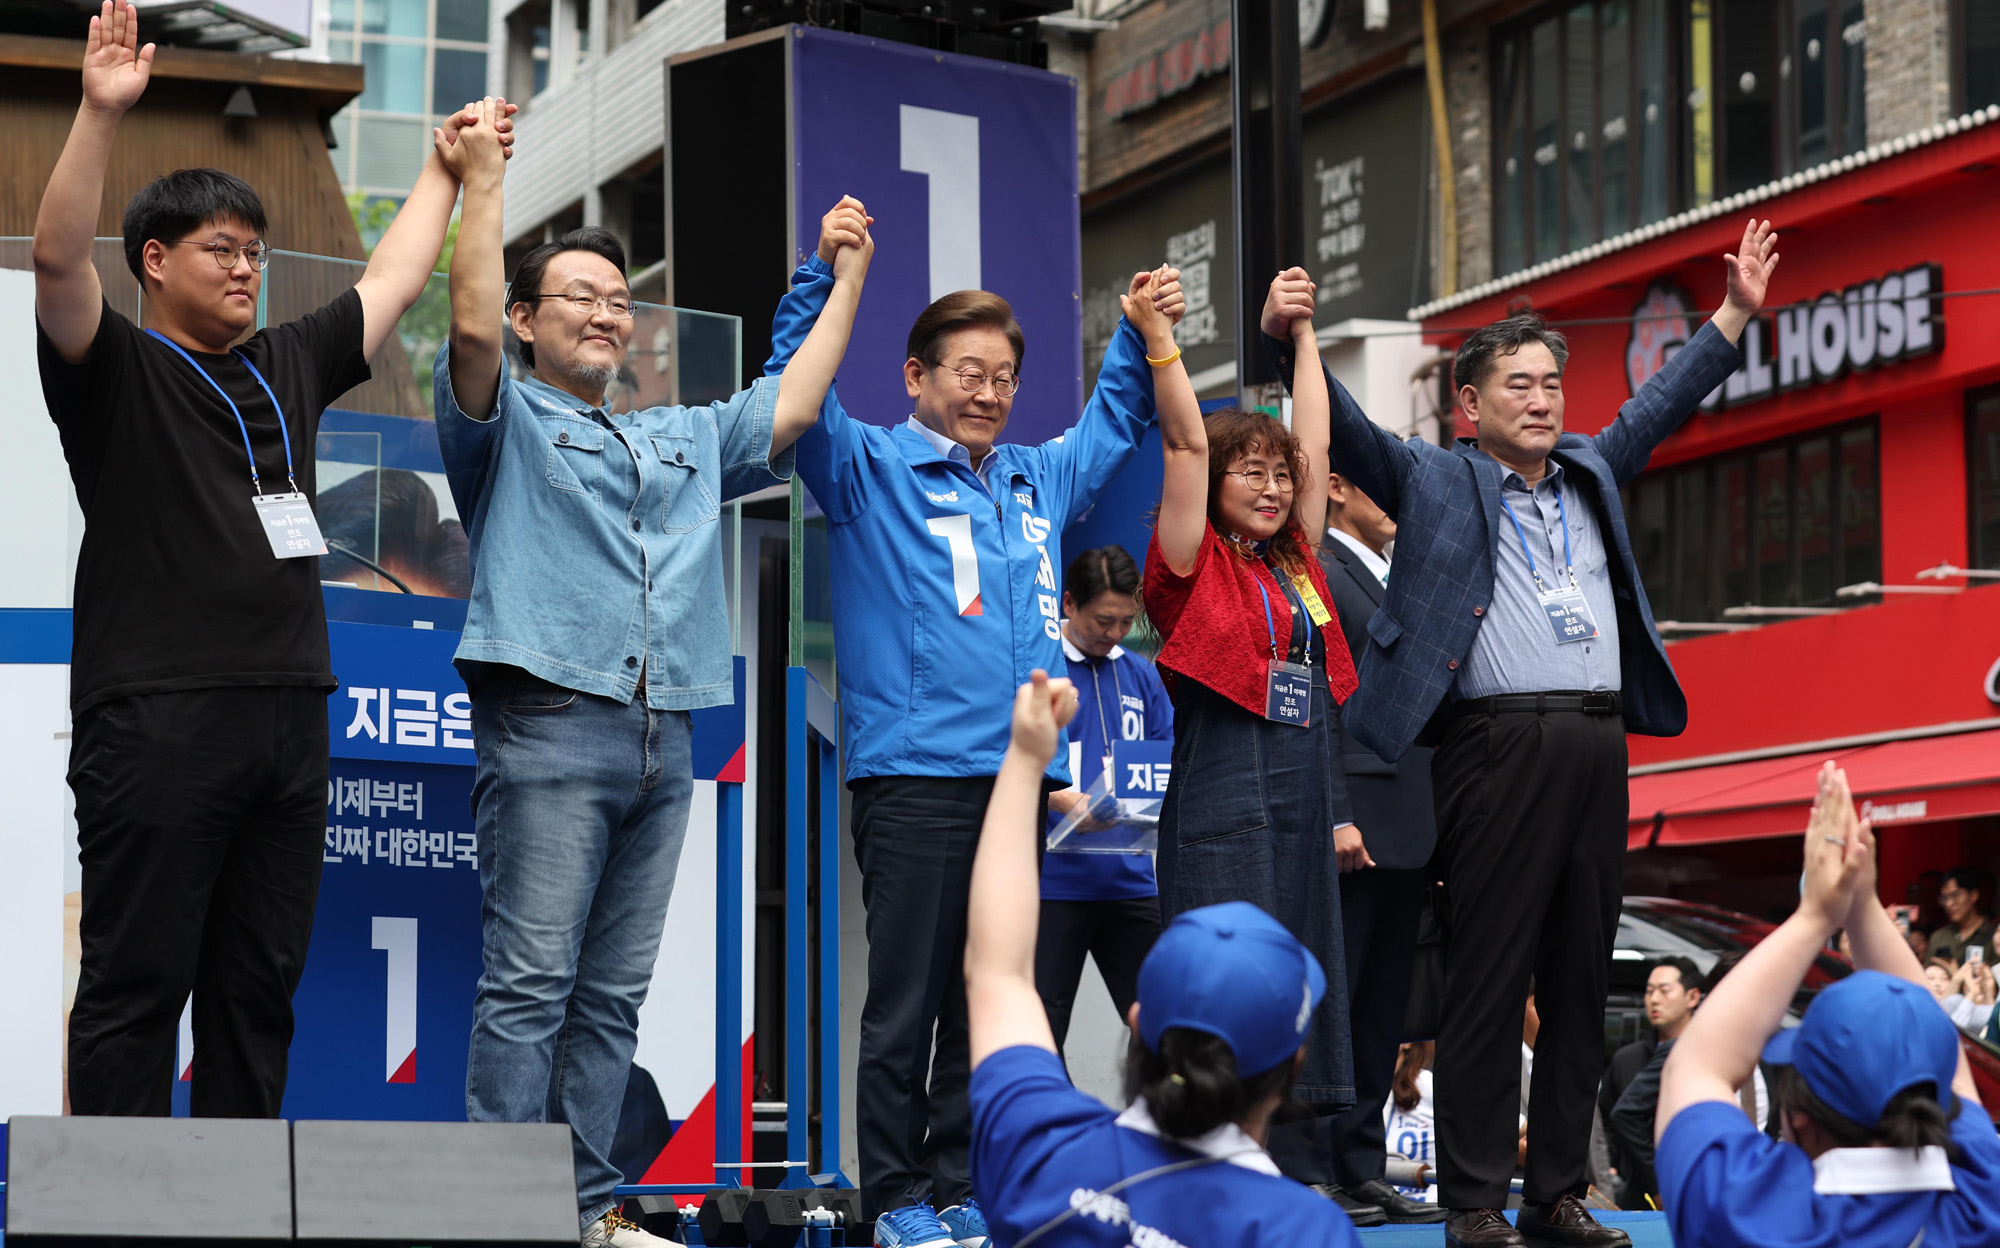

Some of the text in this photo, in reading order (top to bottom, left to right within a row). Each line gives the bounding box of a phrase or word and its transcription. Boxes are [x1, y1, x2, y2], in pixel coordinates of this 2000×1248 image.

[900, 104, 981, 304] 1
[1777, 266, 1932, 387] HOUSE
[285, 514, 293, 526] 1
[286, 538, 312, 550] 연설자
[926, 513, 984, 616] 1
[1563, 605, 1570, 615] 1
[1564, 624, 1586, 636] 연설자
[1288, 683, 1293, 694] 1
[346, 687, 475, 749] 지금은
[1280, 706, 1299, 719] 연설자
[328, 777, 423, 820] 이제부터
[323, 825, 479, 870] 진짜 대한민국
[371, 916, 418, 1083] 1
